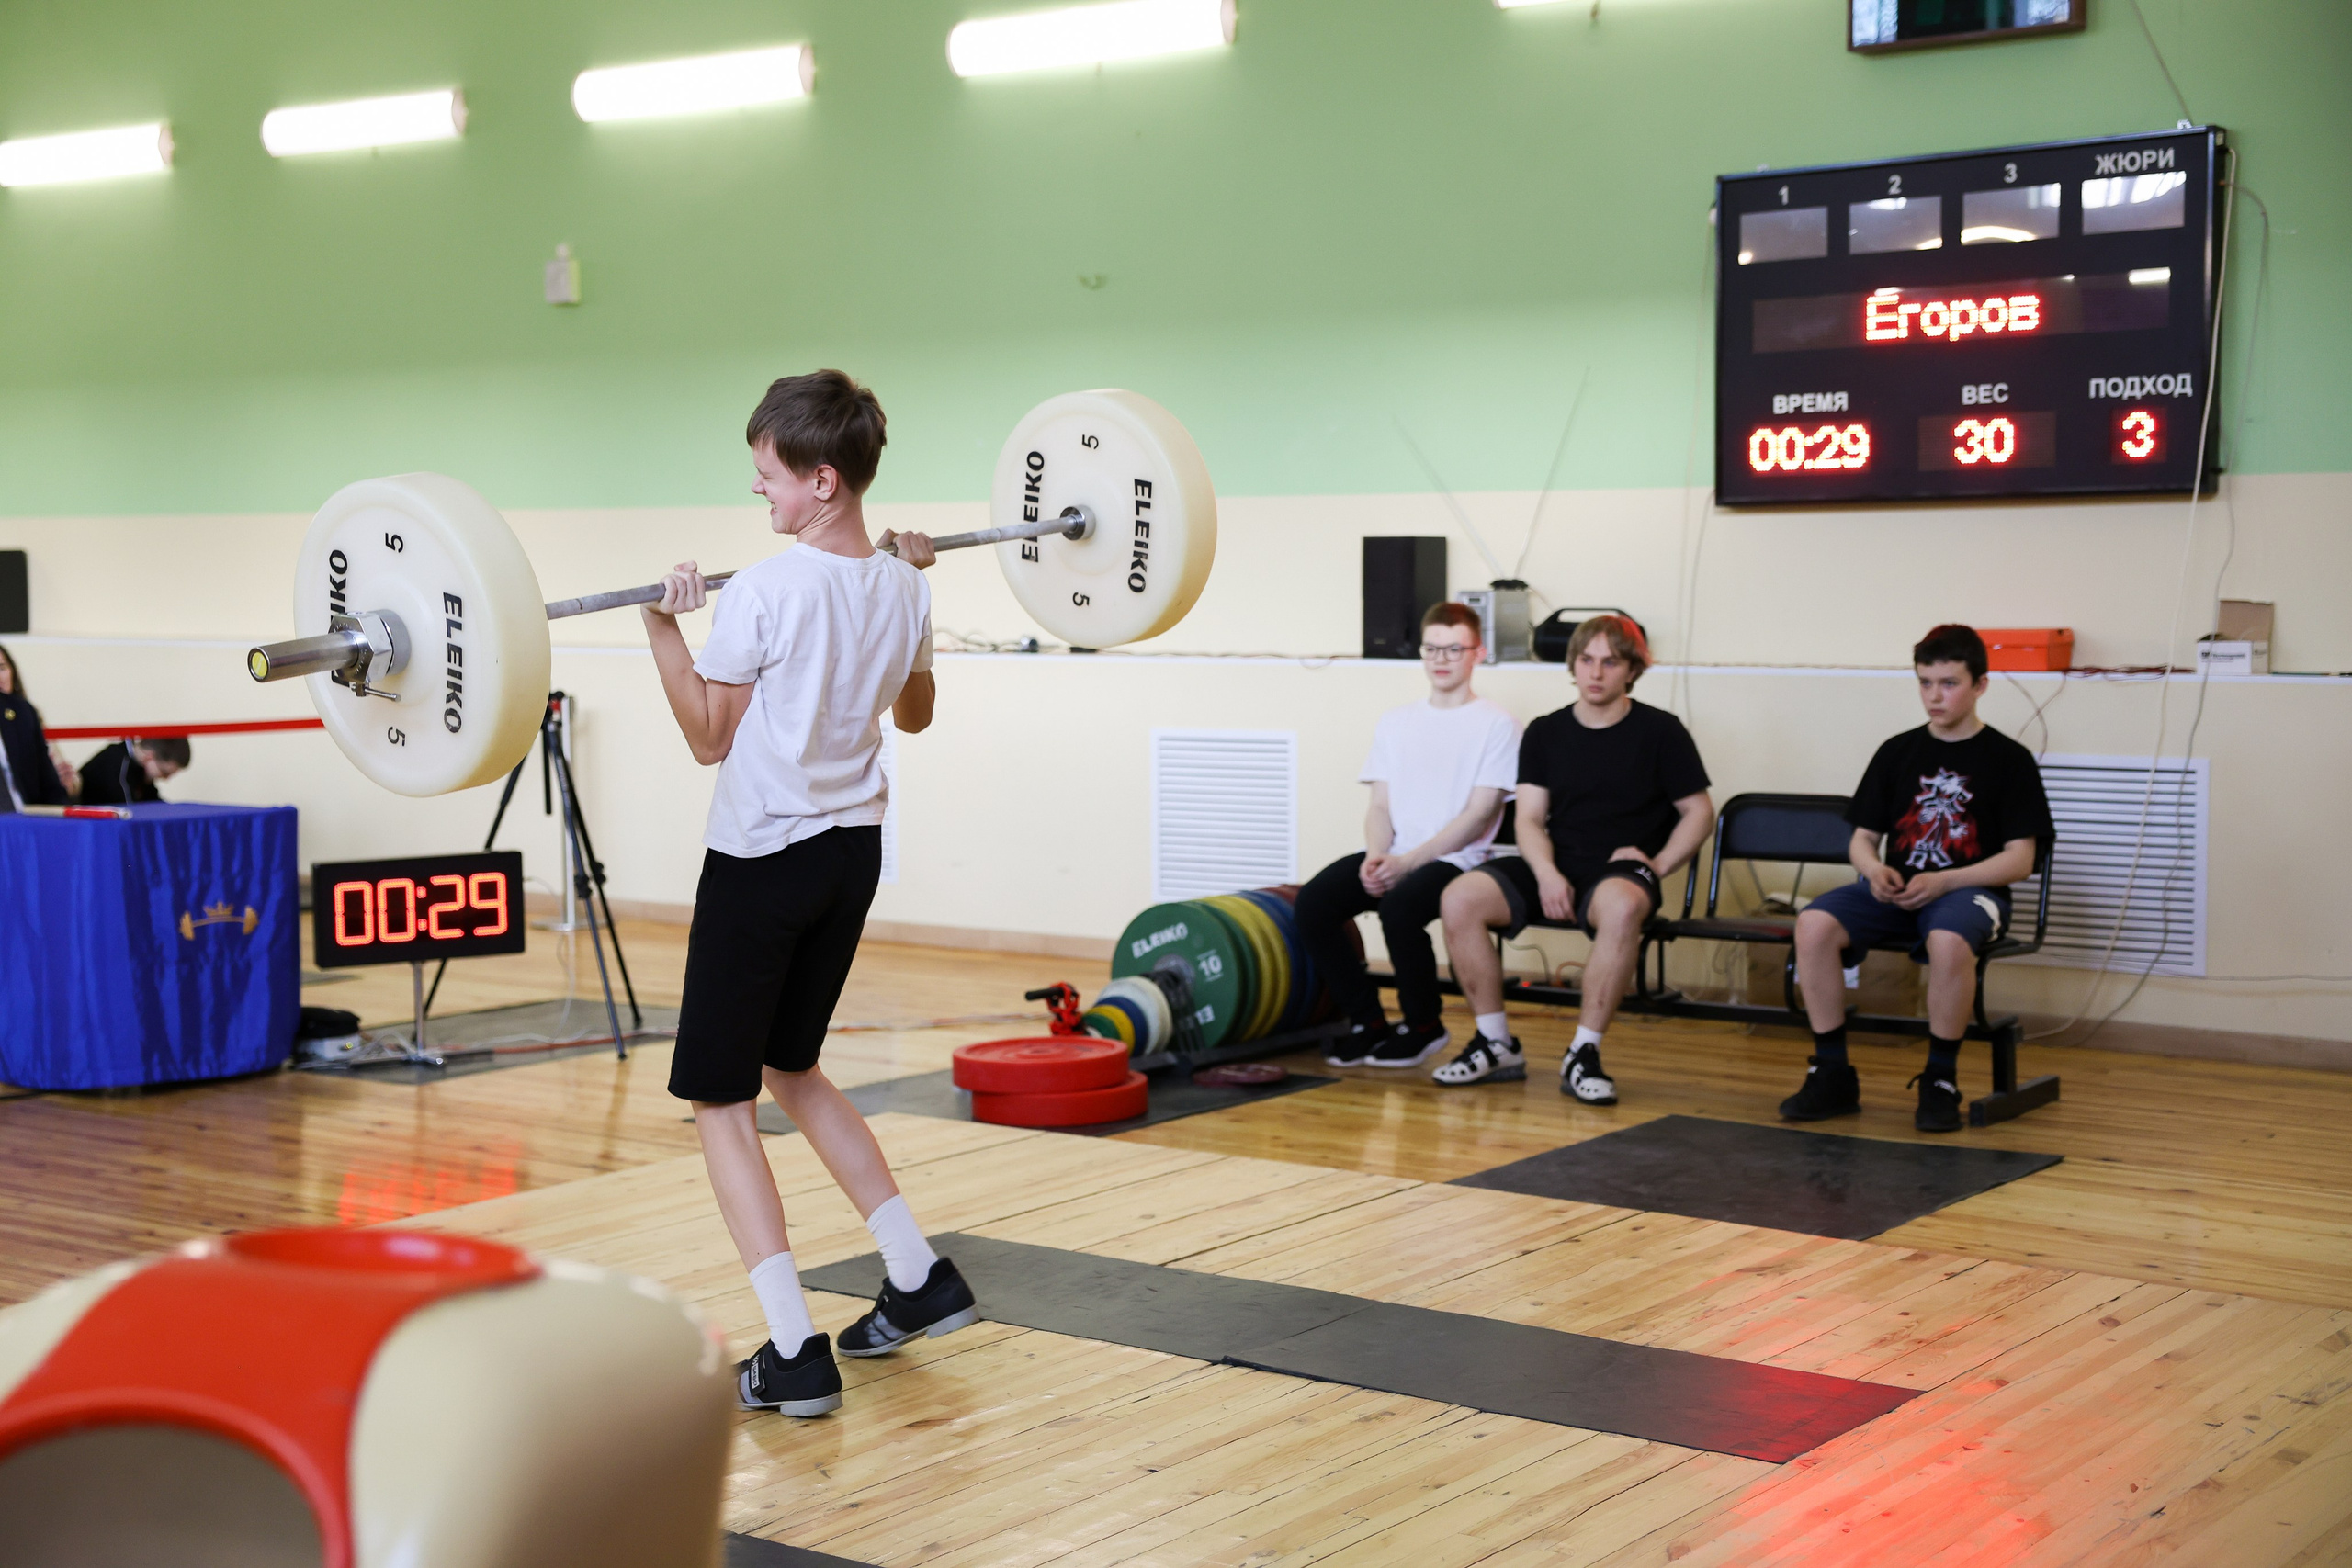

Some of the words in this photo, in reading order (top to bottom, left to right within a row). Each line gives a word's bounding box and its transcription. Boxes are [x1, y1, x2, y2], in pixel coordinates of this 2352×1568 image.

[2004, 163, 2018, 183] 3
[2095, 148, 2176, 175] ЖЮРИ
[1778, 186, 1790, 205] 1
[1888, 175, 1902, 196] 2
[1866, 294, 2040, 342] Егоров
[1962, 383, 2009, 405] ВЕС
[2088, 373, 2193, 400] ПОДХОД
[1772, 391, 1849, 414] ВРЕМЯ
[1081, 434, 1099, 449] 5
[1953, 418, 2015, 464] 30
[2121, 412, 2154, 457] 3
[1749, 424, 1870, 471] 00:29
[385, 532, 403, 553] 5
[1127, 479, 1152, 593] ELEIKO
[1072, 592, 1090, 606] 5
[443, 592, 463, 733] ELEIKO
[387, 726, 405, 746] 5
[334, 872, 507, 946] 00:29
[1131, 922, 1188, 959] ELEIKO
[1198, 954, 1222, 977] 10
